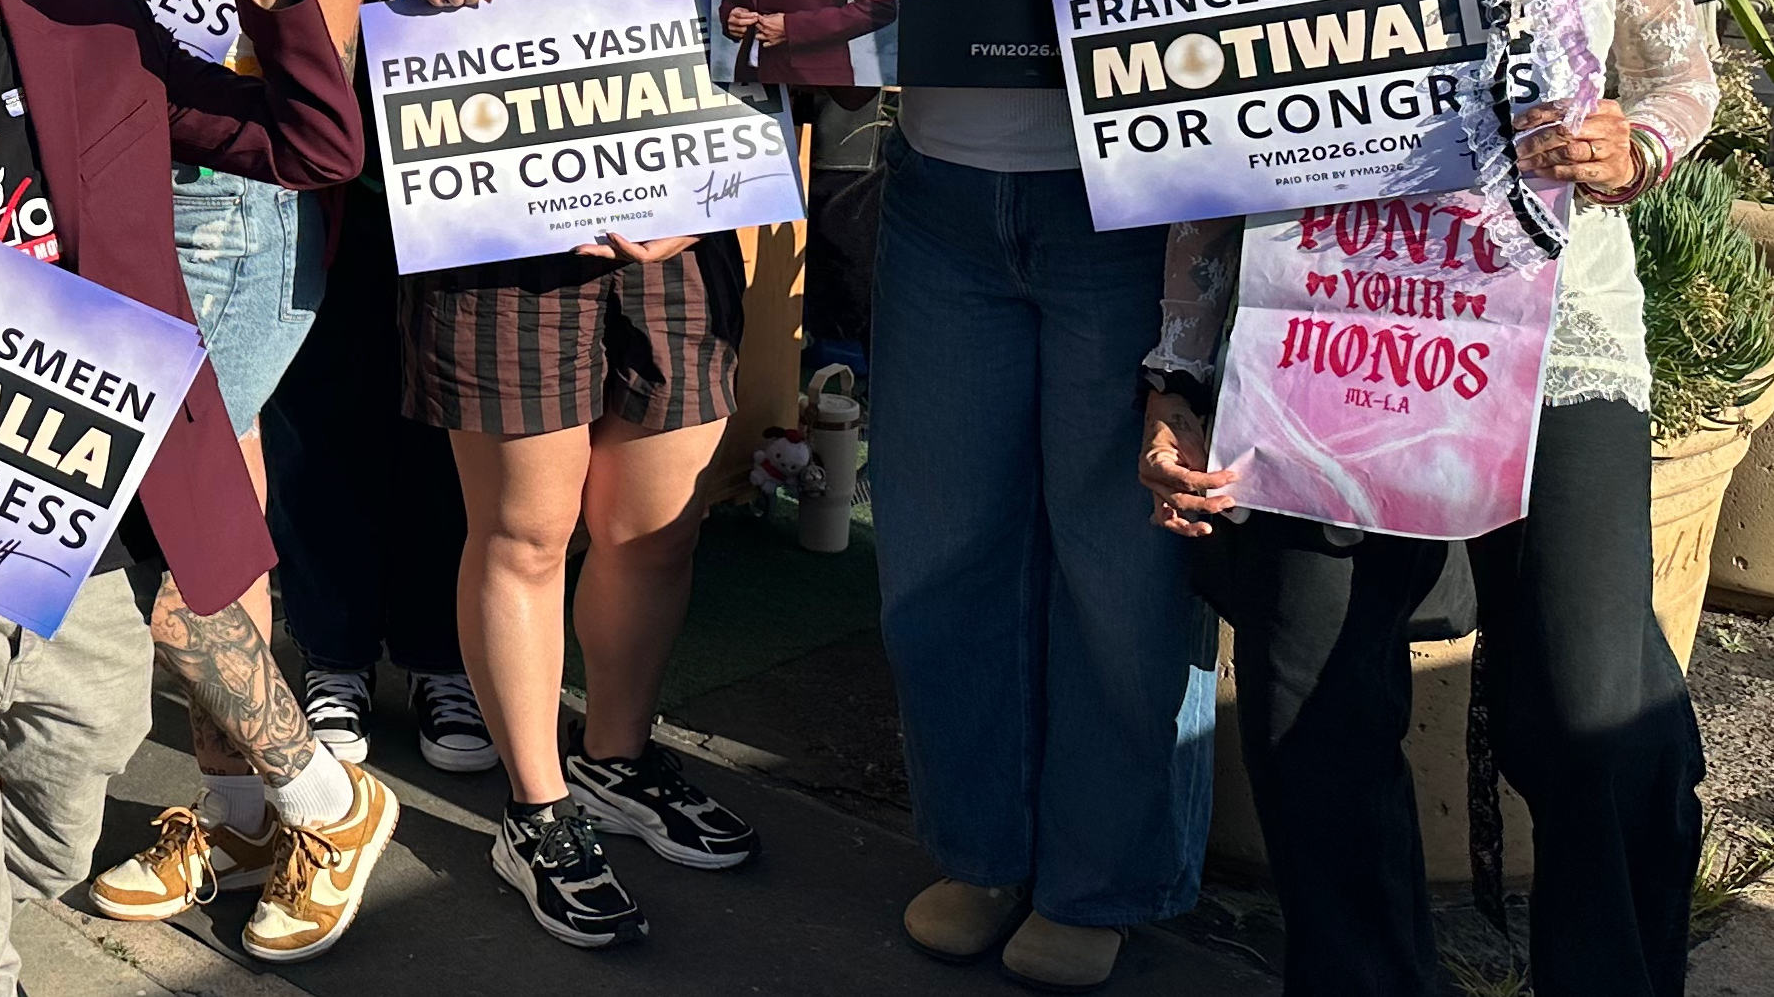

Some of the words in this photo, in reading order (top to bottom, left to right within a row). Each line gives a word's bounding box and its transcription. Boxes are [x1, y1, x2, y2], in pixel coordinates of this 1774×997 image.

[382, 37, 561, 88] FRANCES
[573, 16, 711, 61] YASME
[970, 43, 1061, 56] FYM2026.
[1094, 109, 1210, 160] FOR
[1248, 133, 1423, 170] FYM2026.COM
[401, 160, 498, 205] FOR
[519, 119, 787, 188] CONGRESS
[1275, 175, 1302, 187] PAID
[1305, 171, 1329, 184] FOR
[1332, 169, 1346, 180] BY
[527, 184, 668, 215] FYM2026.COM
[549, 221, 572, 231] PAID
[574, 218, 594, 228] FOR
[596, 216, 607, 225] BY
[1341, 269, 1446, 320] YOUR
[1277, 316, 1491, 400] MOÑOS
